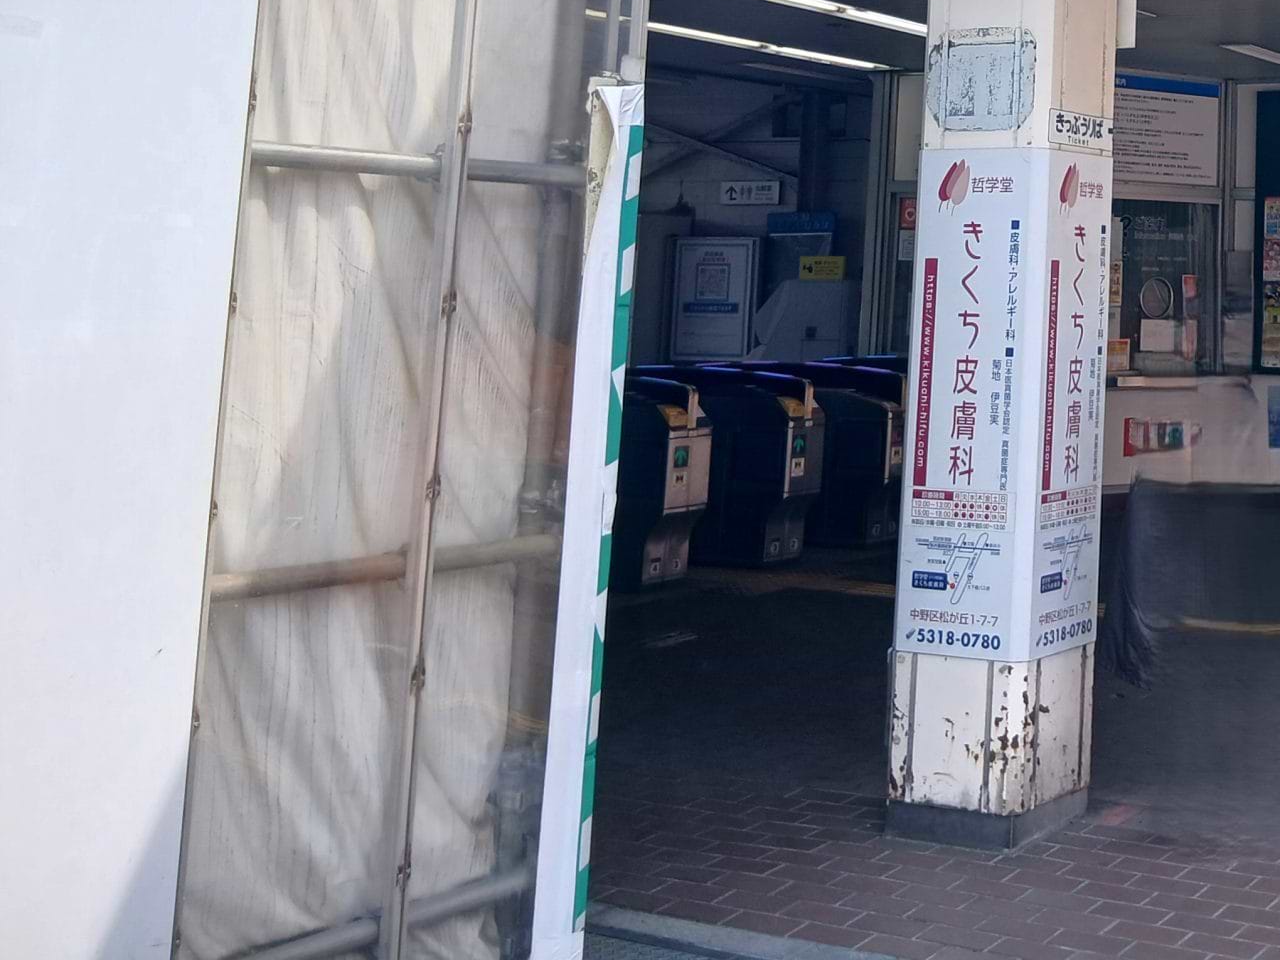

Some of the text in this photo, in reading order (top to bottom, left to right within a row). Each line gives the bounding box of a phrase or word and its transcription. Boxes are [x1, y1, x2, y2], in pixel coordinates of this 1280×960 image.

[1055, 113, 1104, 139] きっぷうりば
[971, 176, 1014, 193] 哲学堂
[1005, 232, 1020, 341] 皮膚科・アレルギー科
[948, 221, 984, 486] きくち皮膚科
[1063, 224, 1086, 483] きくち皮膚科
[910, 608, 998, 627] 中野区松が丘1-7-7
[916, 628, 1001, 650] 5318-0780
[1042, 618, 1092, 647] 5318-0780
